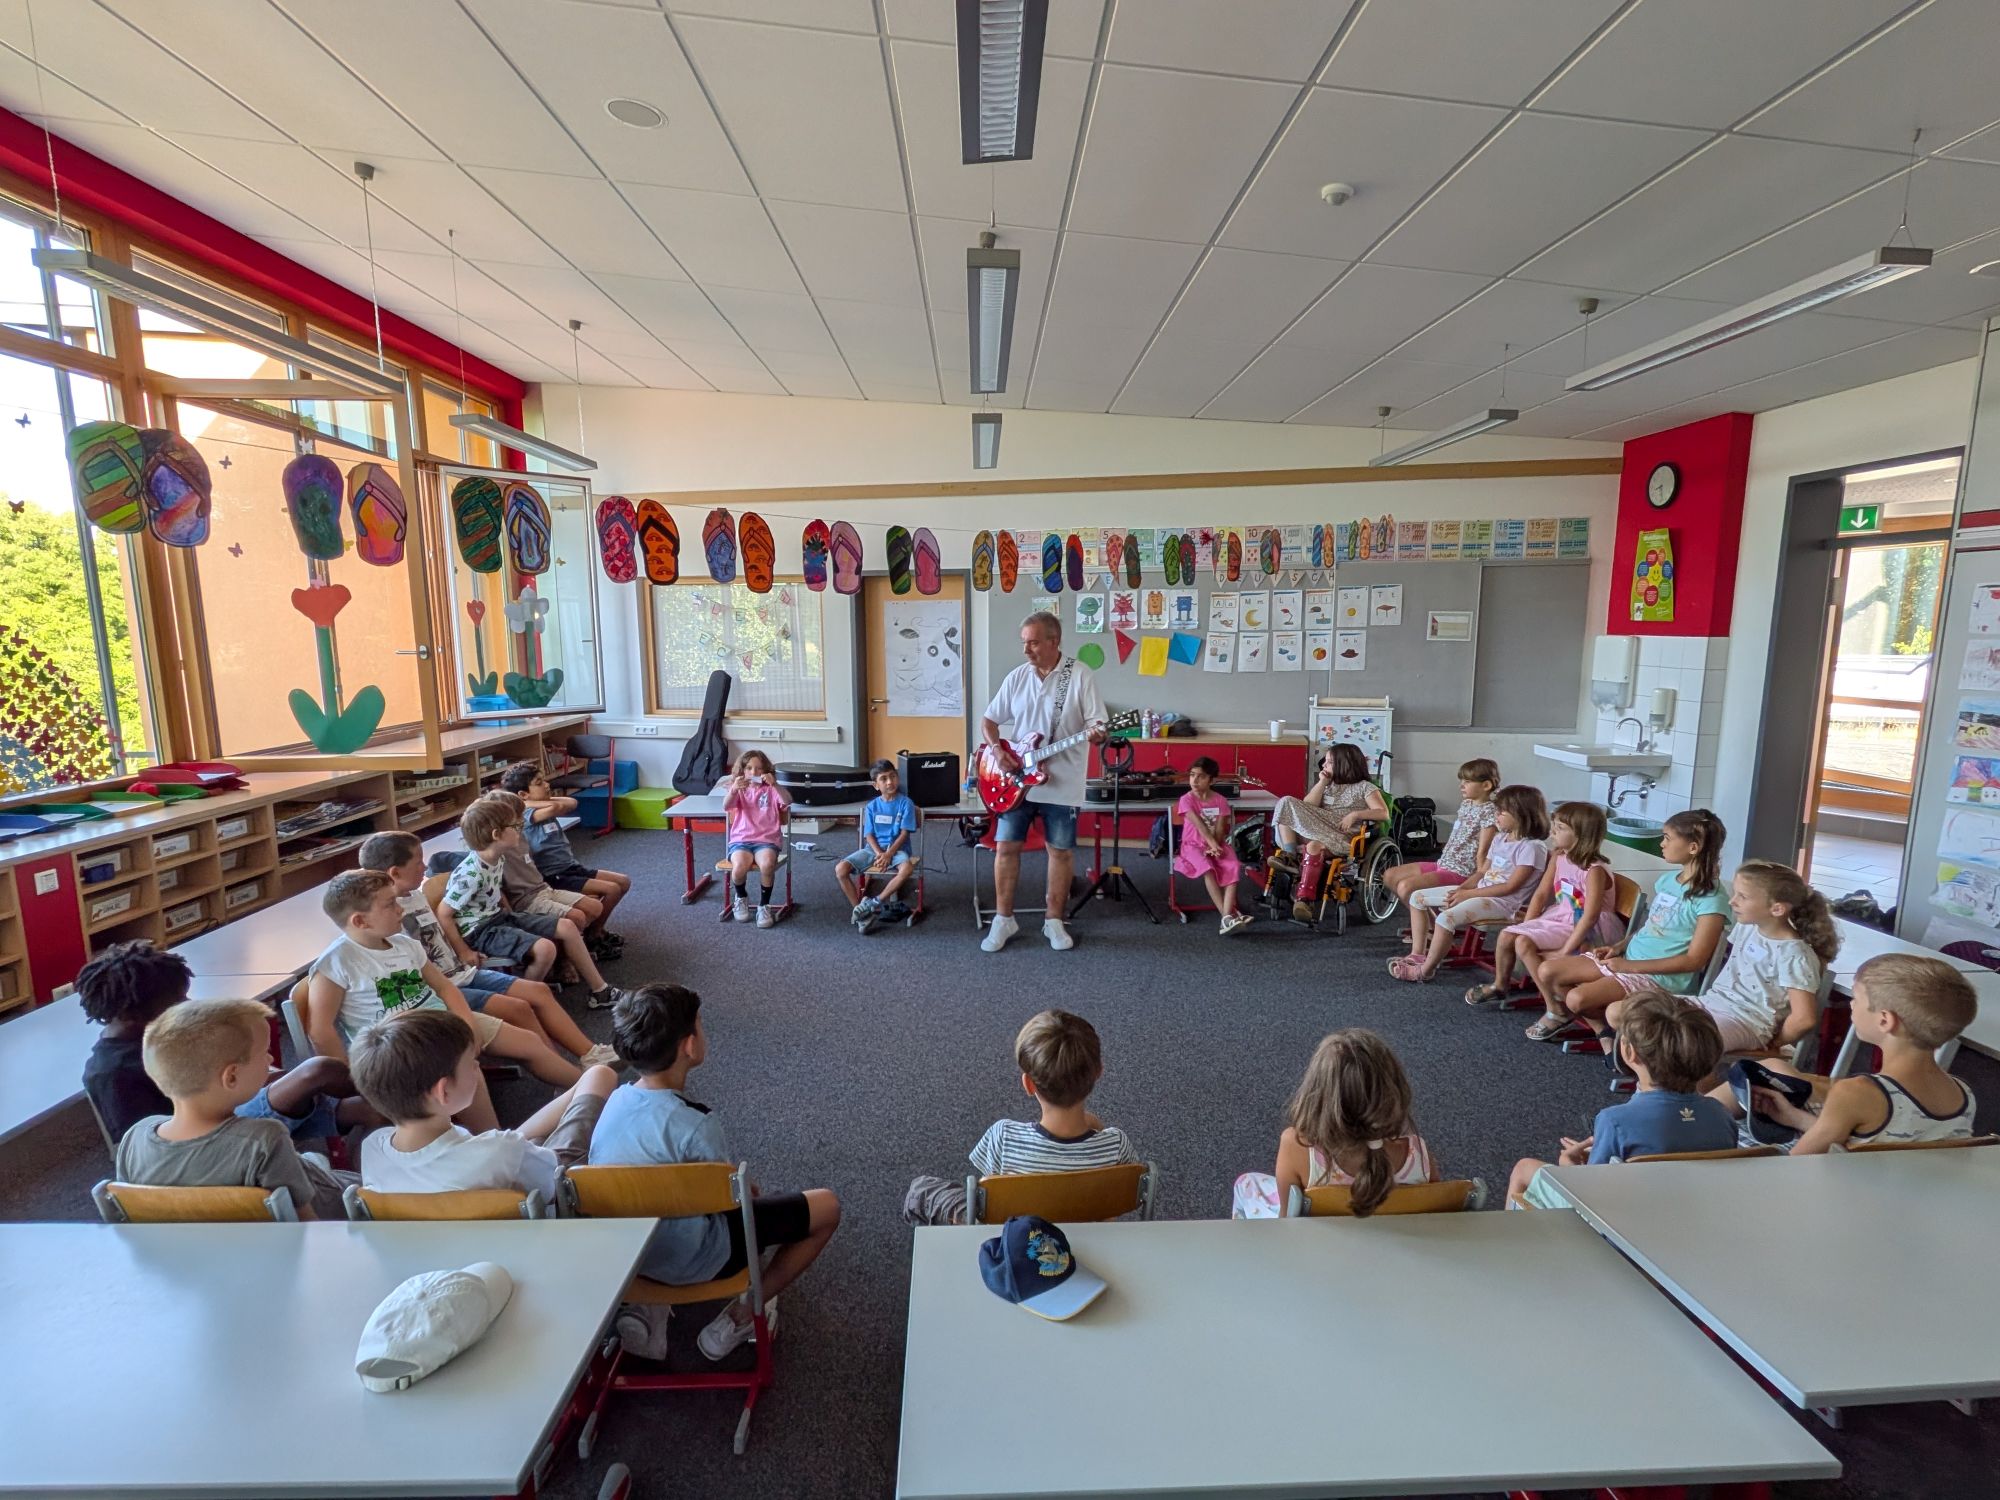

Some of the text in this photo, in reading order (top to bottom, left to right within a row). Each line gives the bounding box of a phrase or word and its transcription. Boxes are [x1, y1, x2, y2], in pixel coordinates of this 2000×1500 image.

[1339, 526, 1348, 534] 13
[1402, 524, 1410, 532] 15
[1467, 523, 1476, 531] 17
[1498, 522, 1508, 530] 18
[1531, 522, 1541, 530] 19
[1103, 530, 1109, 539] 5
[1161, 530, 1167, 540] 7
[1190, 530, 1196, 539] 8
[1248, 528, 1258, 538] 10
[1019, 533, 1025, 543] 2
[921, 760, 946, 769] Marshall
